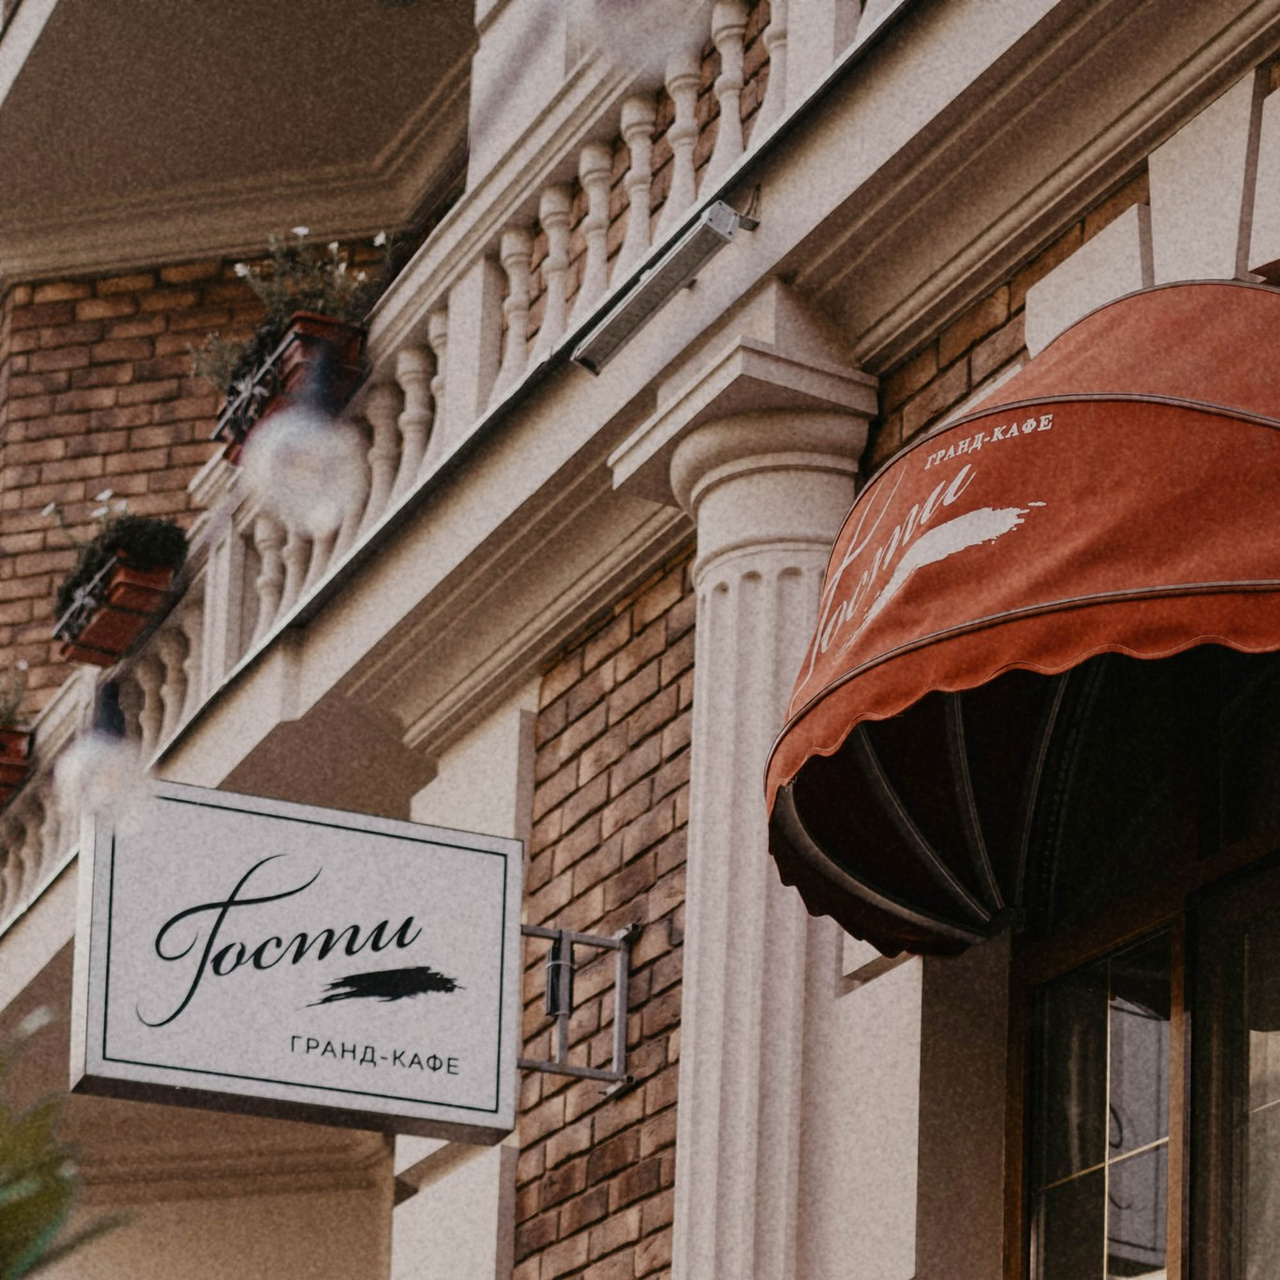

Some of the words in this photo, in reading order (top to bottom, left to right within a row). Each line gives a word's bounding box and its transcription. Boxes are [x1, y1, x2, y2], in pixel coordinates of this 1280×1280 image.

[924, 413, 1054, 470] ГРАНД-КАФЕ
[136, 853, 423, 1027] Гости
[289, 1035, 461, 1076] ГРАНД-КАФЕ
